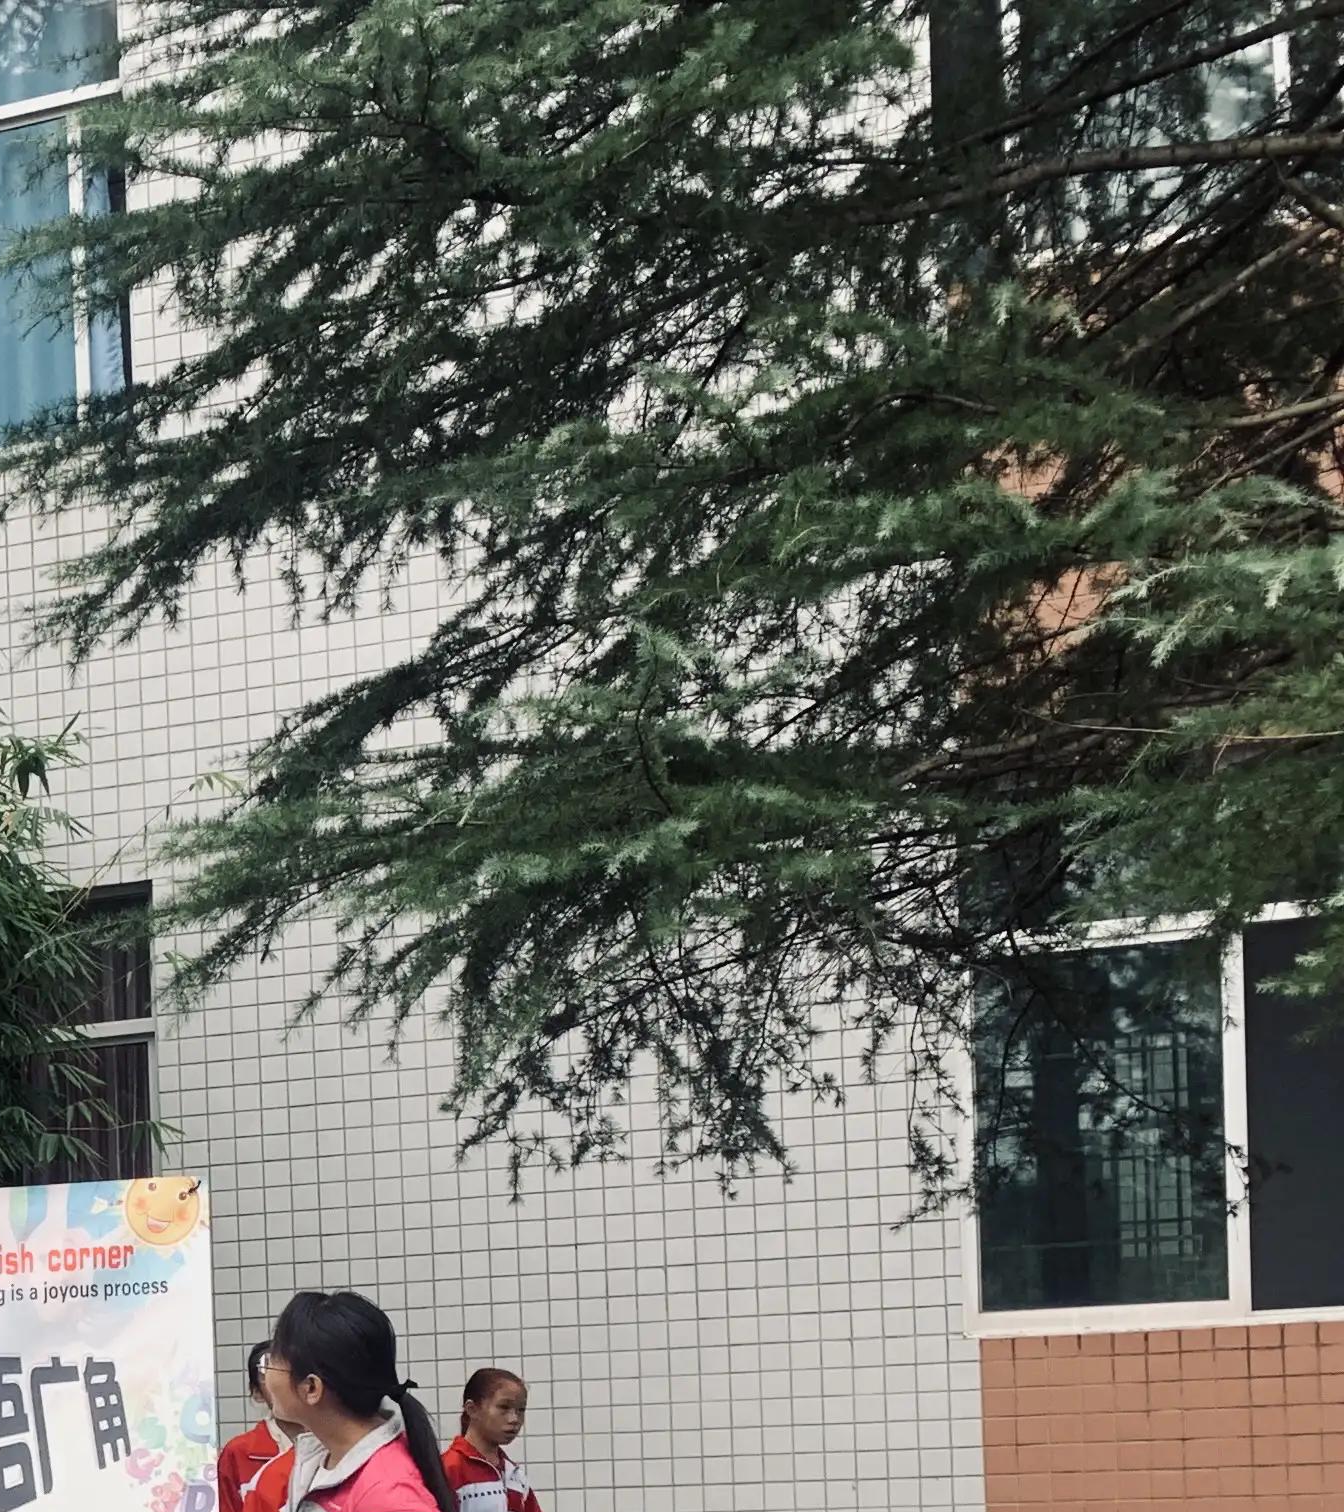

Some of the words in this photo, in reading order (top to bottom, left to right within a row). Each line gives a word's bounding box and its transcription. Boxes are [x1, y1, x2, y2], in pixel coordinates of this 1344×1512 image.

[48, 1244, 135, 1269] corner
[11, 1283, 24, 1301] is
[29, 1287, 39, 1300] a
[43, 1283, 99, 1304] joyous
[103, 1280, 169, 1303] process
